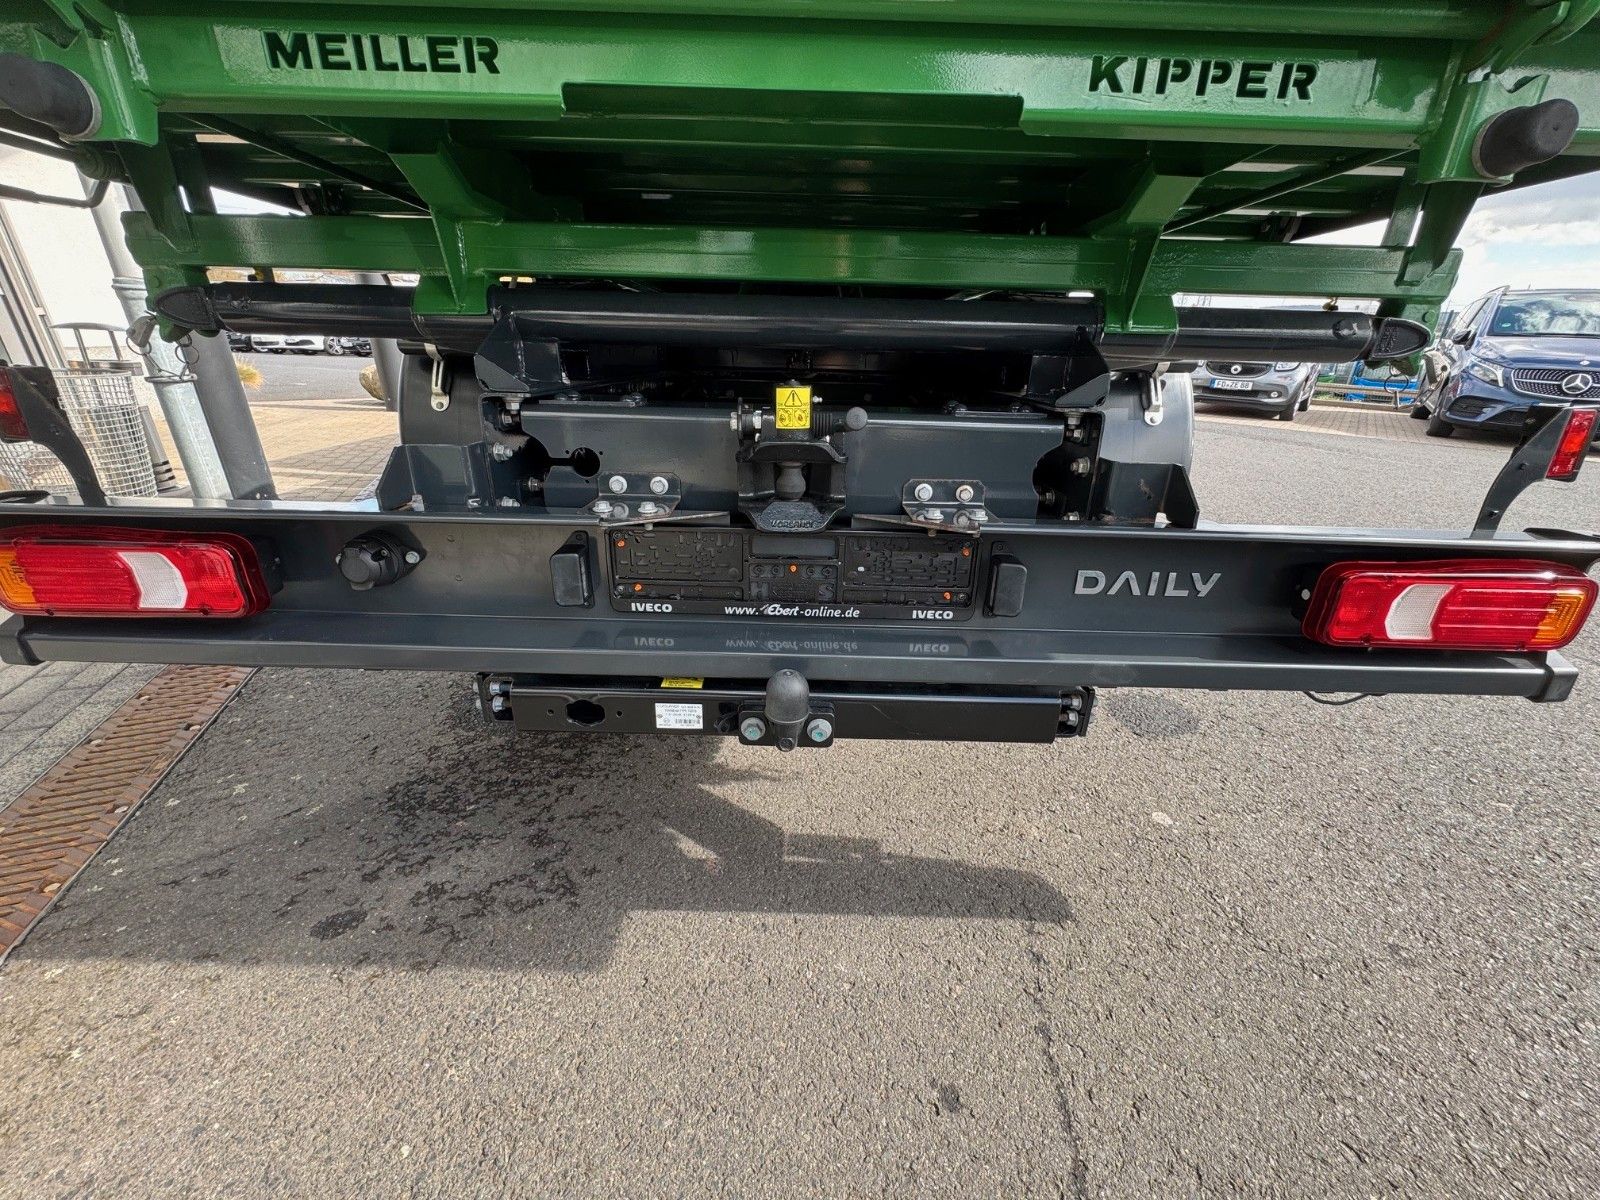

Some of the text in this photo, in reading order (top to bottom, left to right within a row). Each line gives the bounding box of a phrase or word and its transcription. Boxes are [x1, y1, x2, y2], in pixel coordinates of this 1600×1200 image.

[262, 30, 501, 75] MEILLER
[1088, 54, 1319, 101] KIPPER
[1074, 569, 1222, 598] DAILY
[631, 602, 673, 613] IVECO
[911, 609, 954, 620] IVECO
